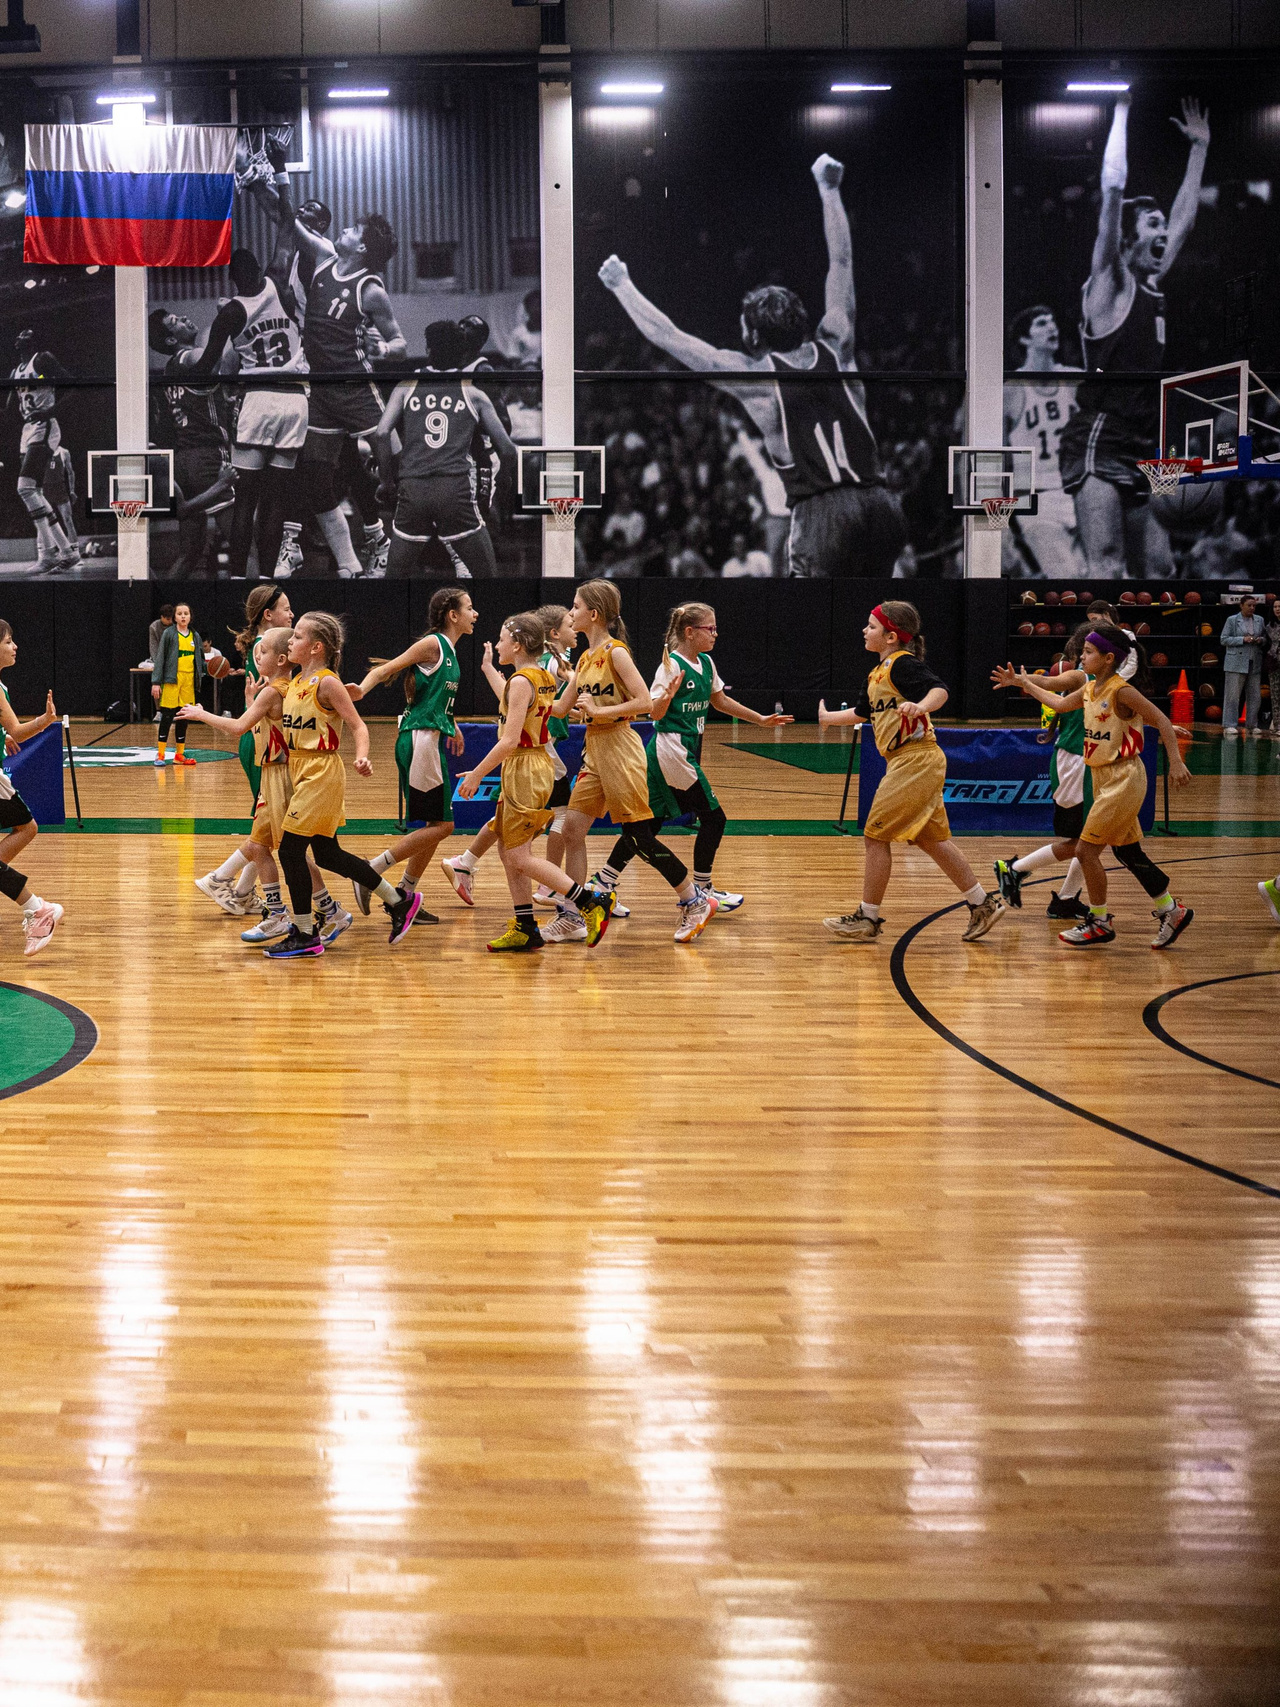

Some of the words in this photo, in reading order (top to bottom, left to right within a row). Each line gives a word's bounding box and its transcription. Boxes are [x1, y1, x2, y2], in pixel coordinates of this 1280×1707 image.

[327, 297, 348, 320] 11
[252, 331, 291, 368] 13
[409, 394, 466, 413] СССР
[424, 411, 449, 449] 9
[682, 701, 701, 713] ГРИН
[942, 783, 1018, 799] TART
[266, 892, 281, 903] 23
